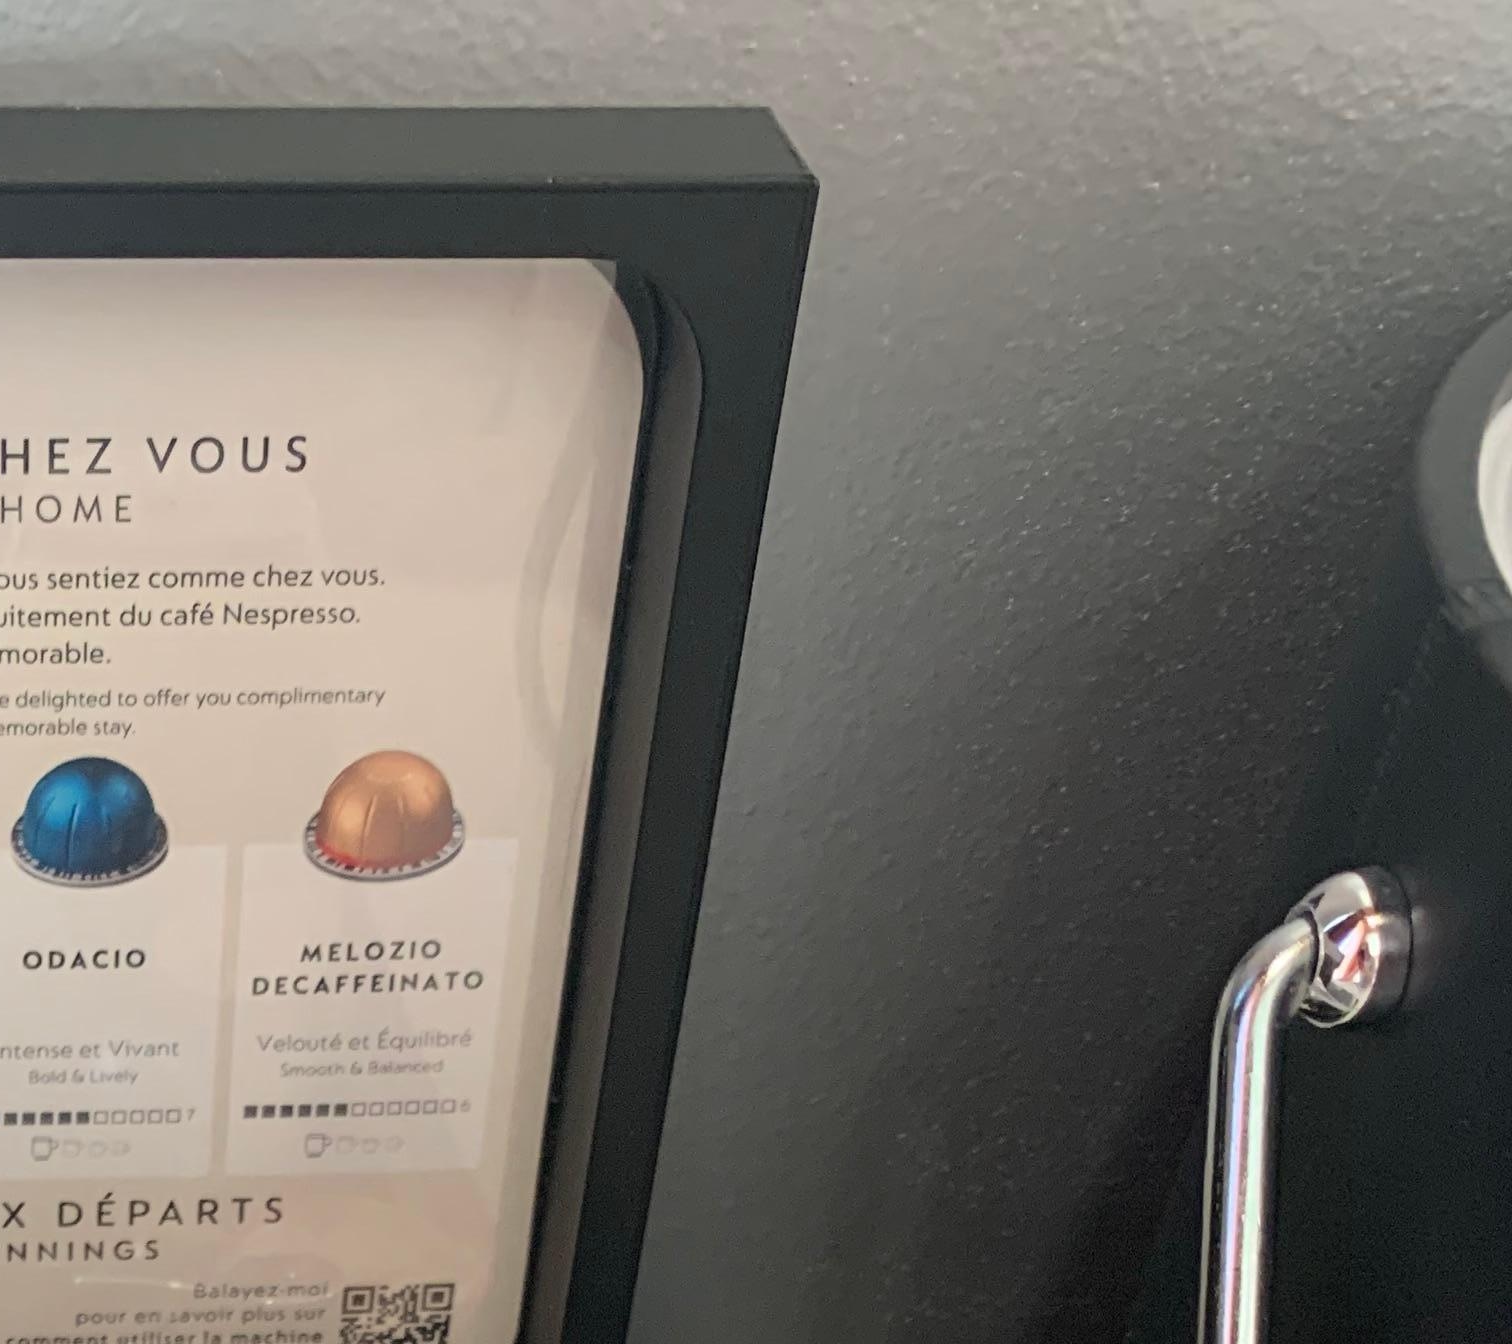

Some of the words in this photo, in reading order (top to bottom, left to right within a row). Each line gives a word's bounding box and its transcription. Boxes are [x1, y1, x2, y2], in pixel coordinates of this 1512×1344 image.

[146, 435, 306, 474] VOUS
[1, 494, 131, 524] HOME
[48, 566, 140, 590] sentiez
[149, 570, 245, 589] comme
[253, 563, 312, 587] chez
[321, 569, 384, 586] vous.
[120, 602, 151, 627] du
[160, 601, 214, 626] café
[223, 602, 359, 631] Nespresso.
[15, 690, 111, 713] delighted
[118, 693, 137, 707] to
[143, 687, 190, 707] offer
[196, 692, 231, 710] you
[237, 687, 385, 709] complimentary
[94, 720, 135, 739] stay.
[23, 949, 145, 970] ODACIO
[300, 939, 441, 963] MELOZIO
[252, 971, 483, 996] DECAFFEINATO
[79, 1044, 100, 1059] et
[109, 1040, 179, 1058] Vivant
[256, 1032, 343, 1053] Velouté
[348, 1035, 370, 1052] et
[377, 1026, 472, 1054] Équilibré
[28, 1068, 67, 1084] Bold
[89, 1068, 138, 1085] Lively
[280, 1061, 345, 1078] Smooth
[368, 1059, 444, 1075] Balanced
[58, 1193, 282, 1227] DÉPARTS
[193, 1281, 328, 1301] Balayez-moi
[75, 1311, 126, 1329] pour
[134, 1311, 161, 1325] en
[169, 1306, 234, 1324] savoir
[241, 1305, 286, 1326] plus
[294, 1306, 326, 1321] sur
